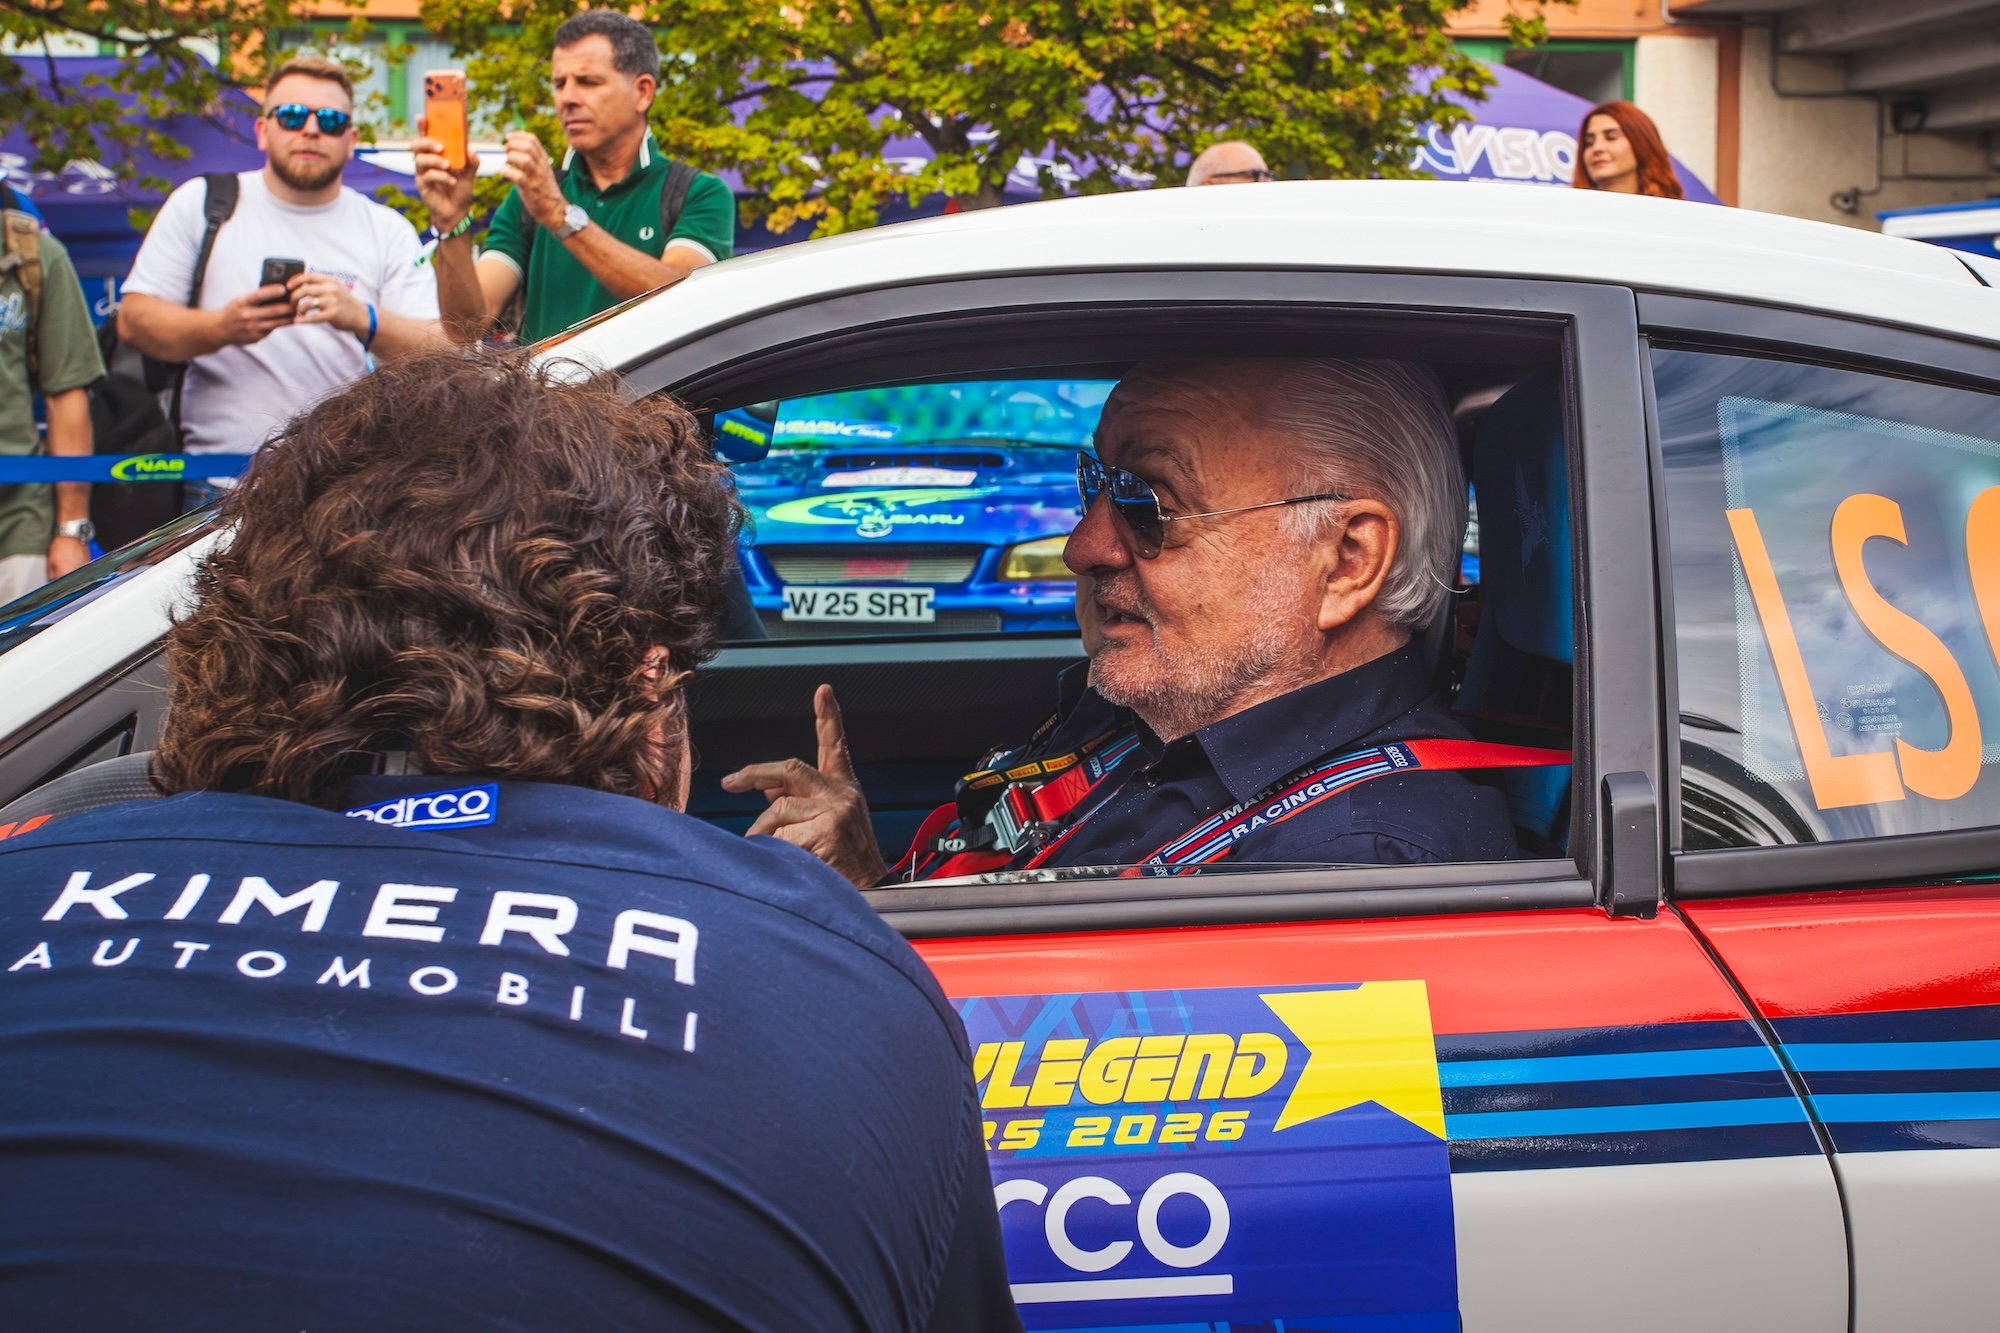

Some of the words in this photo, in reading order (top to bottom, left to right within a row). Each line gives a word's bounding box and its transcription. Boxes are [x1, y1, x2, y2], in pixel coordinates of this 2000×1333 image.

[789, 592, 817, 616] W
[824, 592, 859, 616] 25
[867, 592, 928, 616] SRT
[1725, 484, 2000, 810] LS
[1231, 782, 1327, 839] RACING
[41, 870, 700, 985] KIMERA
[7, 937, 698, 1052] AUTOMOBILI
[1066, 1109, 1251, 1148] 2026
